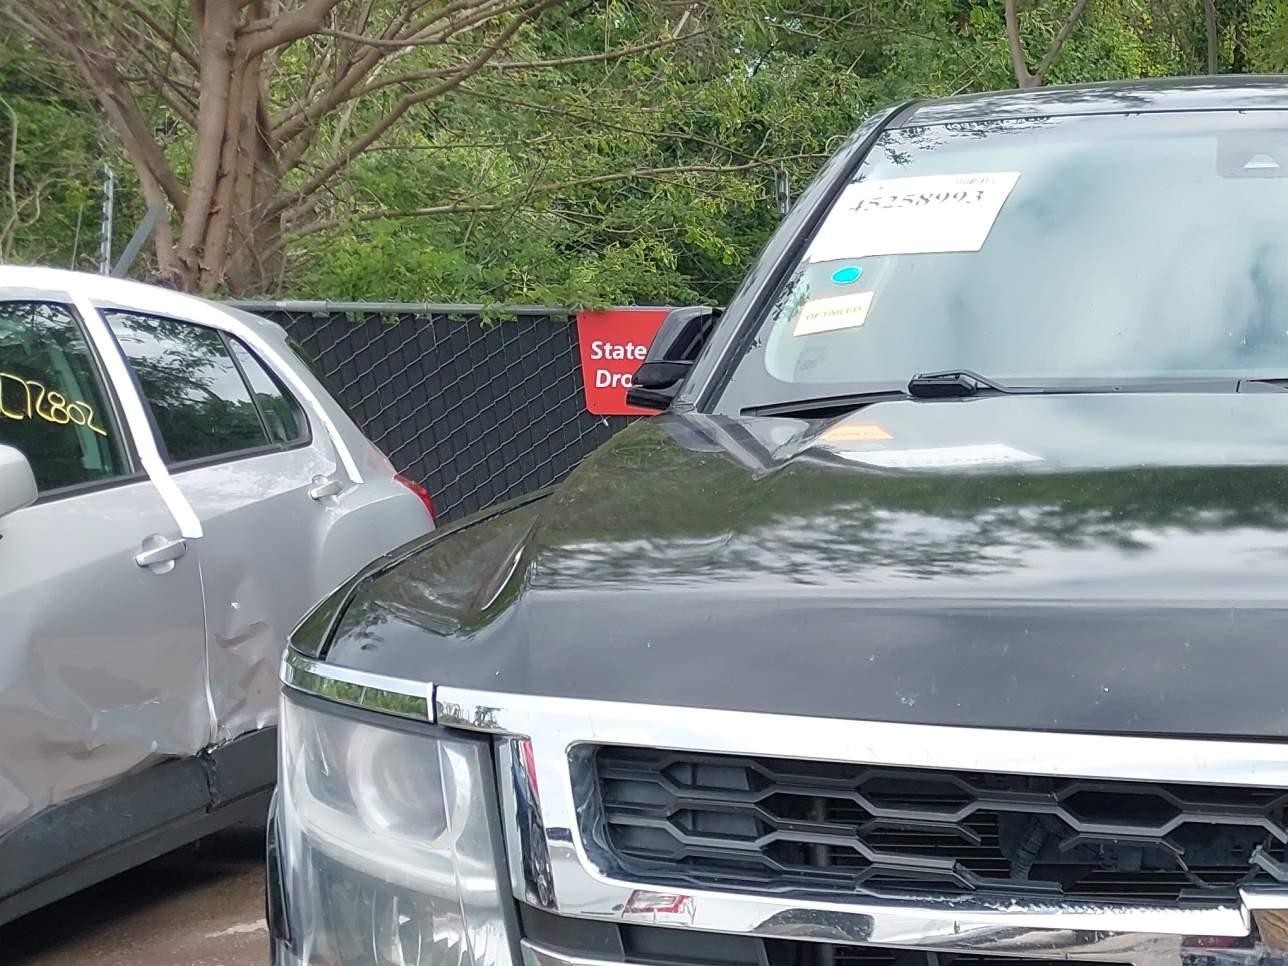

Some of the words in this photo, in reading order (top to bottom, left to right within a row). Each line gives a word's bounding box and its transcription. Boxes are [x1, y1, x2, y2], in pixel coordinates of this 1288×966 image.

[848, 189, 986, 214] 45258993
[591, 340, 647, 360] State
[595, 369, 634, 388] Dro
